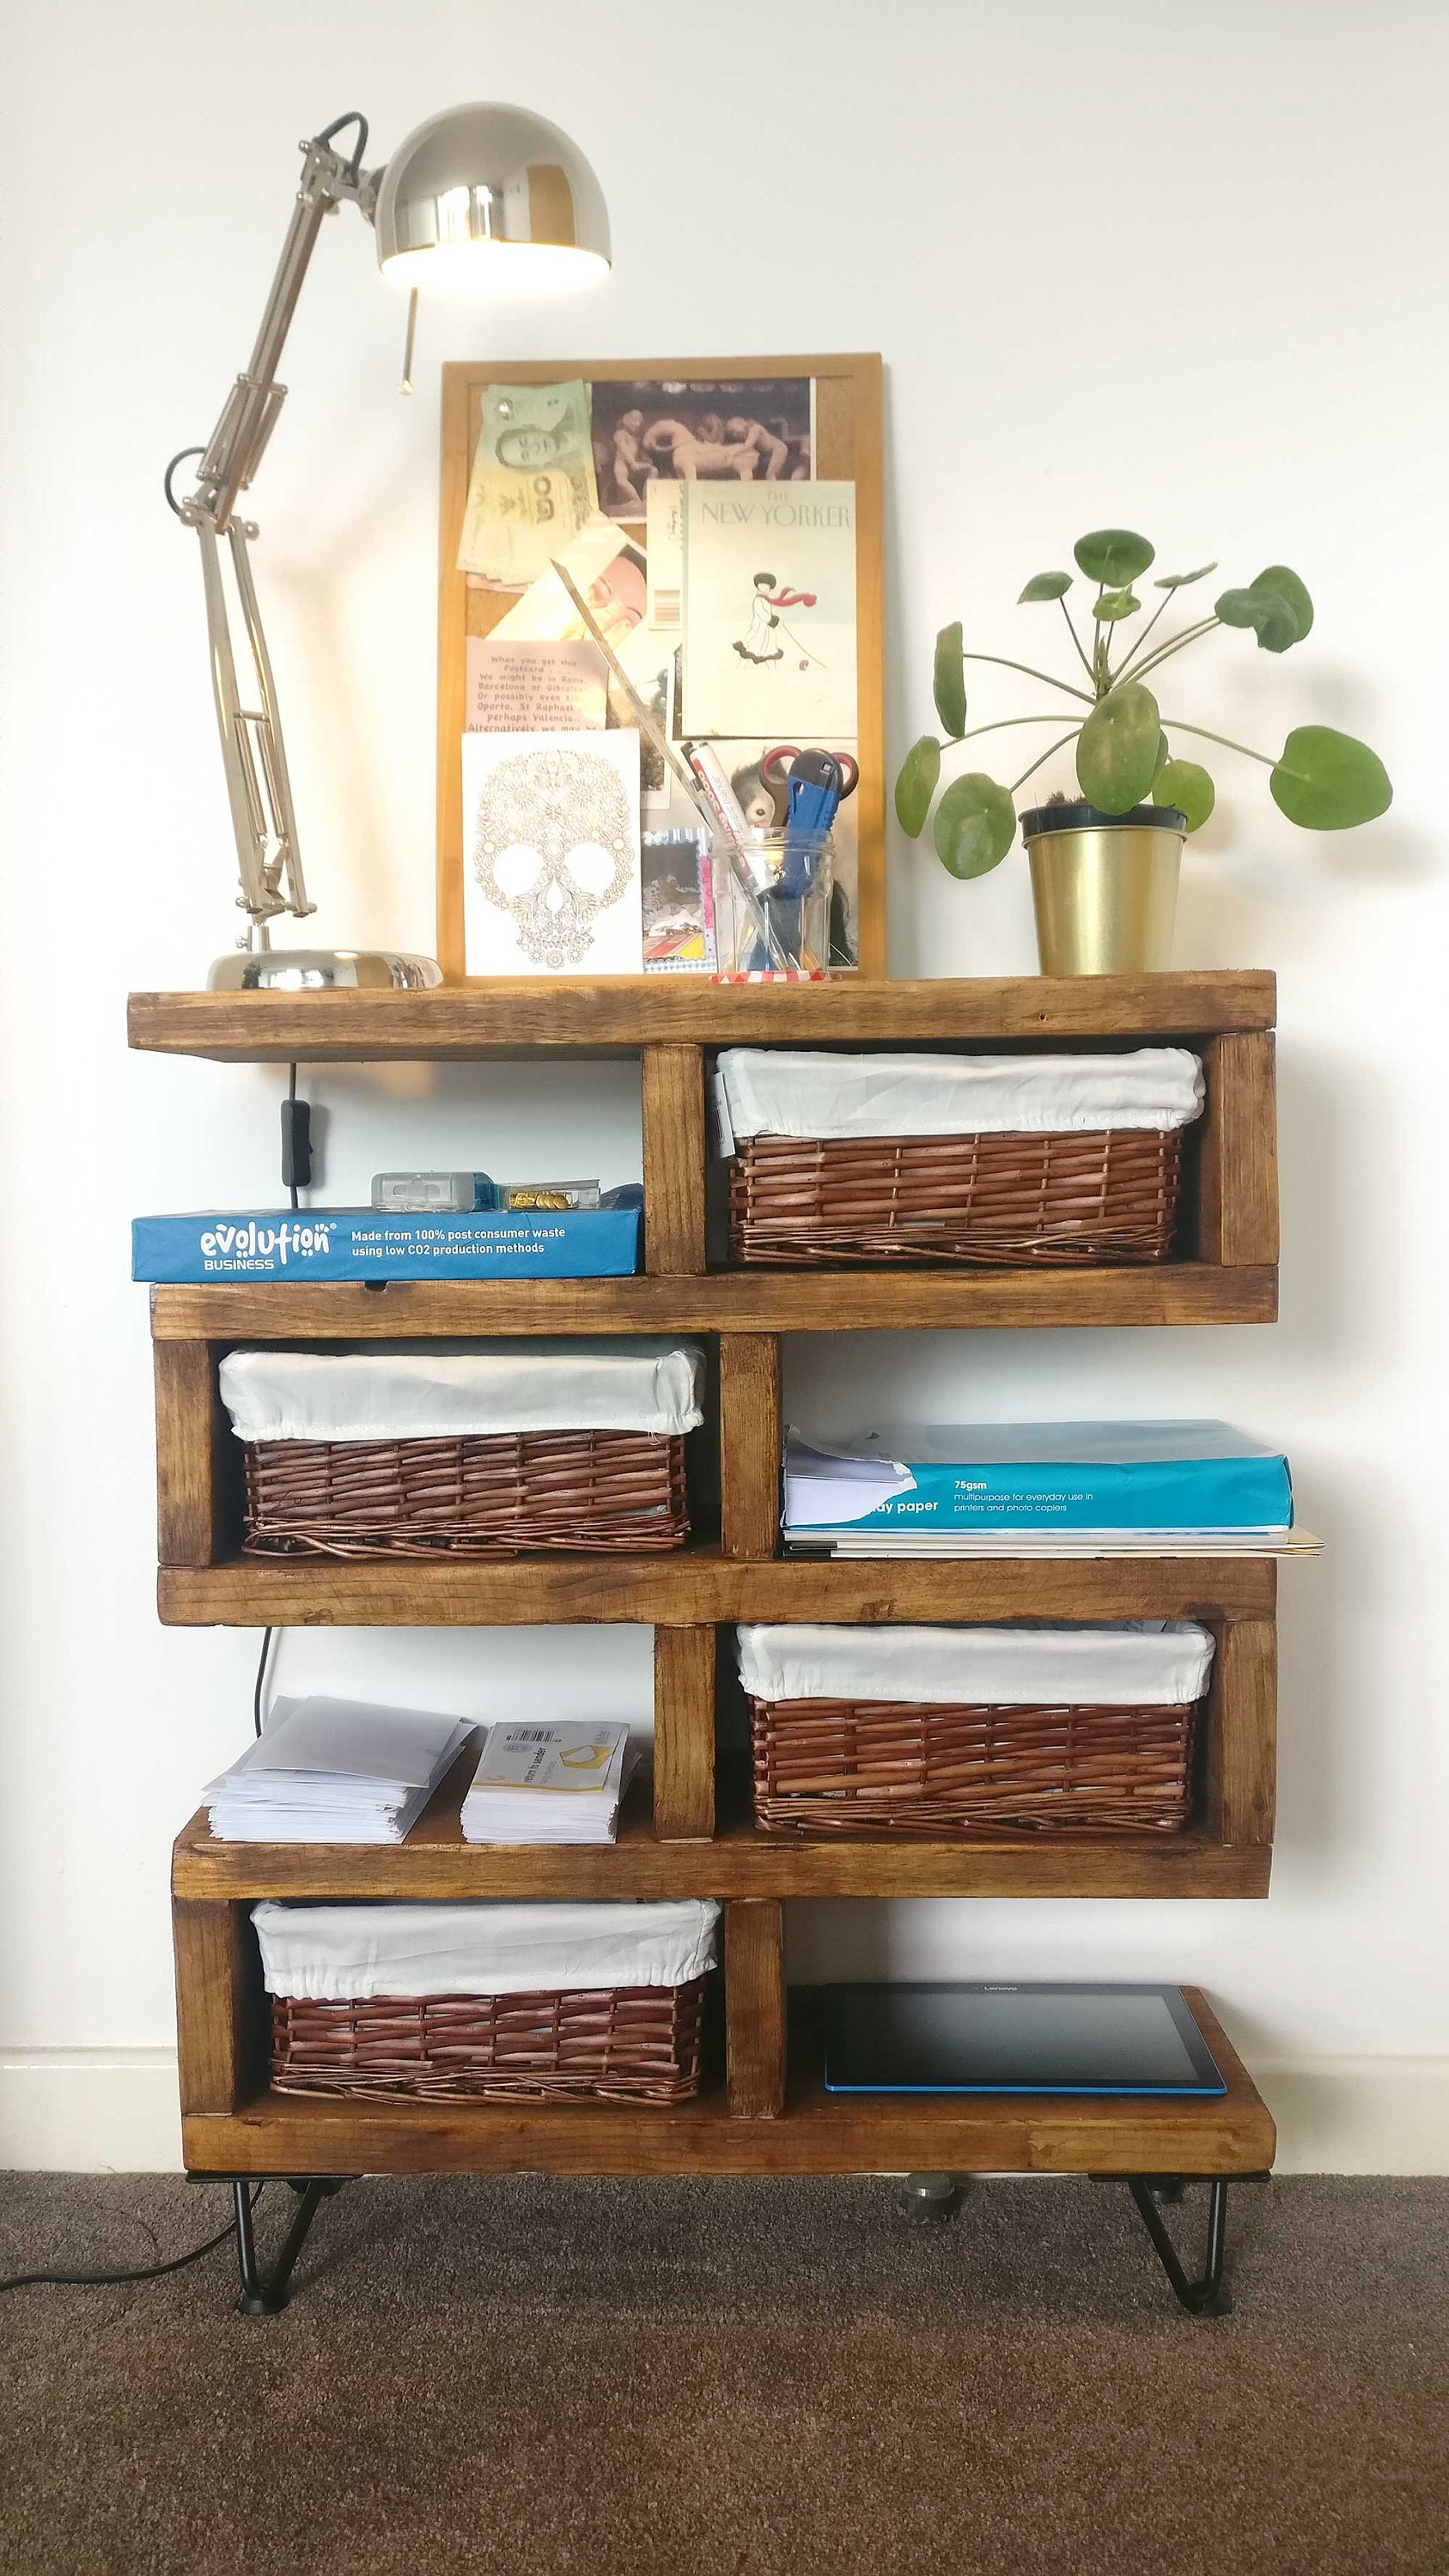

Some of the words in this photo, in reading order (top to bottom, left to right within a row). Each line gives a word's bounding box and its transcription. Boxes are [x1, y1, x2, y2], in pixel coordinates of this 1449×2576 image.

[767, 491, 788, 501] THE
[701, 502, 755, 525] NEW
[761, 504, 851, 528] YORKER
[541, 657, 555, 665] get
[561, 659, 577, 667] this
[499, 674, 526, 683] might
[494, 693, 533, 702] possibly
[487, 713, 527, 722] perhaps
[468, 724, 535, 732] Alternatively
[351, 1231, 381, 1241] Made
[384, 1230, 411, 1240] from
[415, 1230, 445, 1240] 100%
[447, 1230, 472, 1242] post
[474, 1229, 529, 1239] consumer
[533, 1228, 565, 1237] waste
[200, 1221, 330, 1265] evolution
[352, 1245, 383, 1257] using
[386, 1245, 405, 1255] low
[408, 1245, 429, 1255] CO2
[433, 1244, 492, 1256] production
[496, 1243, 544, 1254] methods
[204, 1259, 274, 1270] BUSINESS
[954, 1480, 987, 1491] 75gsm
[954, 1492, 1010, 1502] multipurpose
[1012, 1492, 1024, 1501] for
[1026, 1492, 1066, 1502] everyday
[898, 1501, 938, 1514] paper
[954, 1504, 984, 1514] printers
[987, 1504, 1005, 1512] and
[1007, 1504, 1032, 1514] photo
[1034, 1504, 1067, 1514] copiers
[533, 1747, 546, 1765] sender
